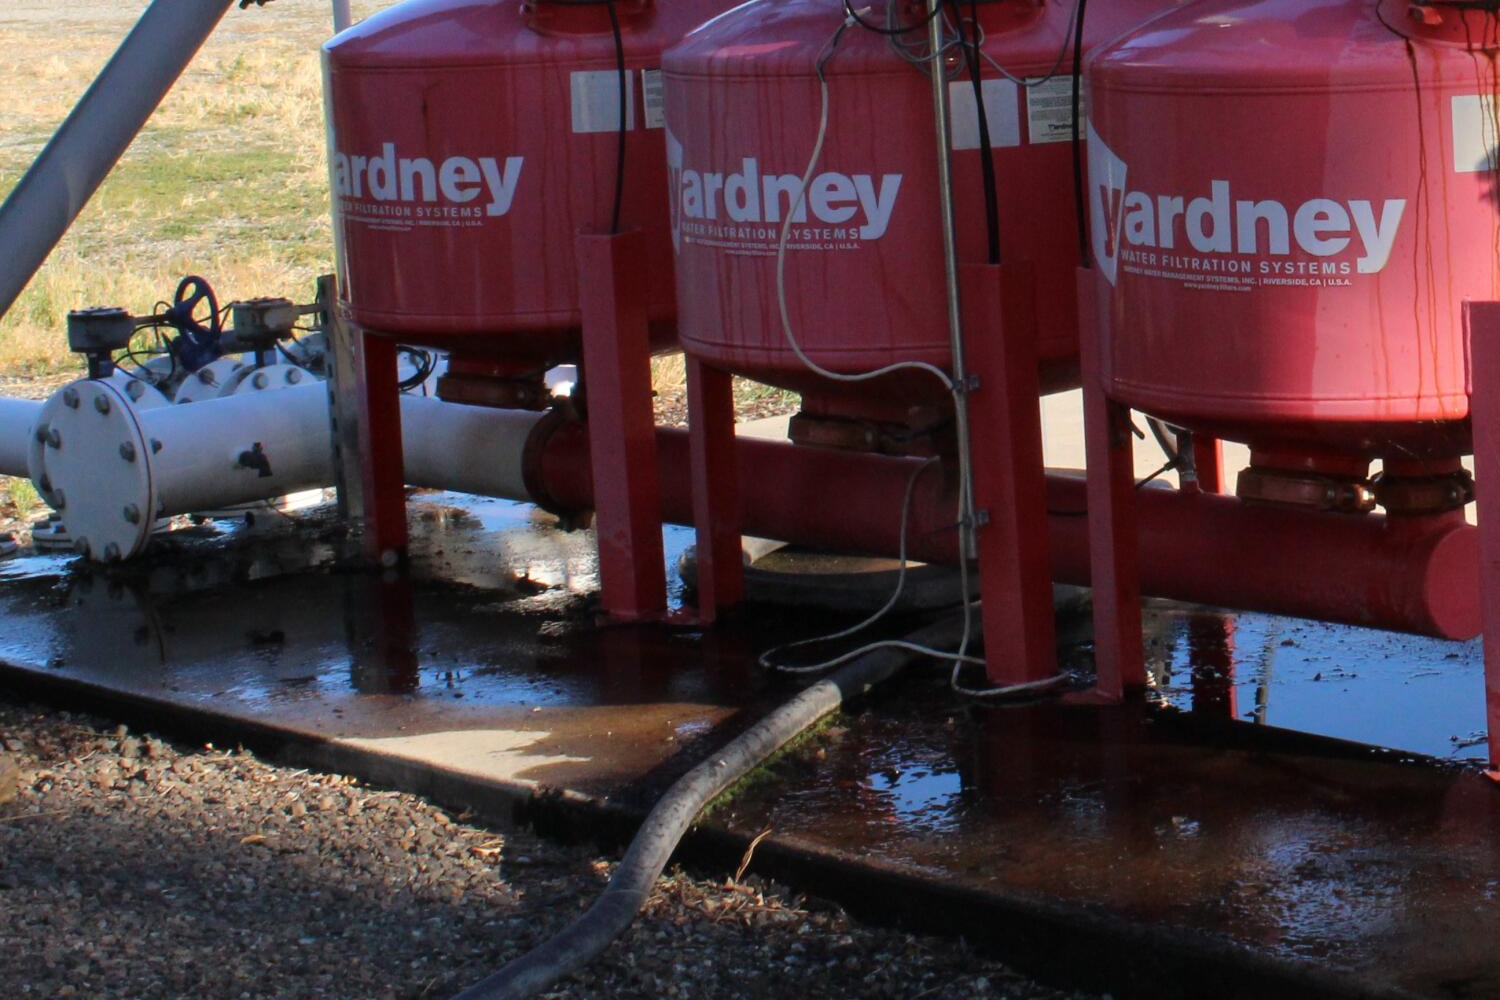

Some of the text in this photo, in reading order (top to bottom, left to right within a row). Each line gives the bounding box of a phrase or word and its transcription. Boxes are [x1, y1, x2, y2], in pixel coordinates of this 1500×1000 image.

[334, 142, 525, 217] ardney
[416, 207, 483, 218] SYSTEMS
[708, 225, 776, 240] FILTRATION
[784, 228, 859, 240] YSTEMS
[1121, 248, 1352, 275] WATER FILTRATION SYSTEMS
[1242, 276, 1257, 285] INC.
[1263, 278, 1308, 287] RIVERSIDE,
